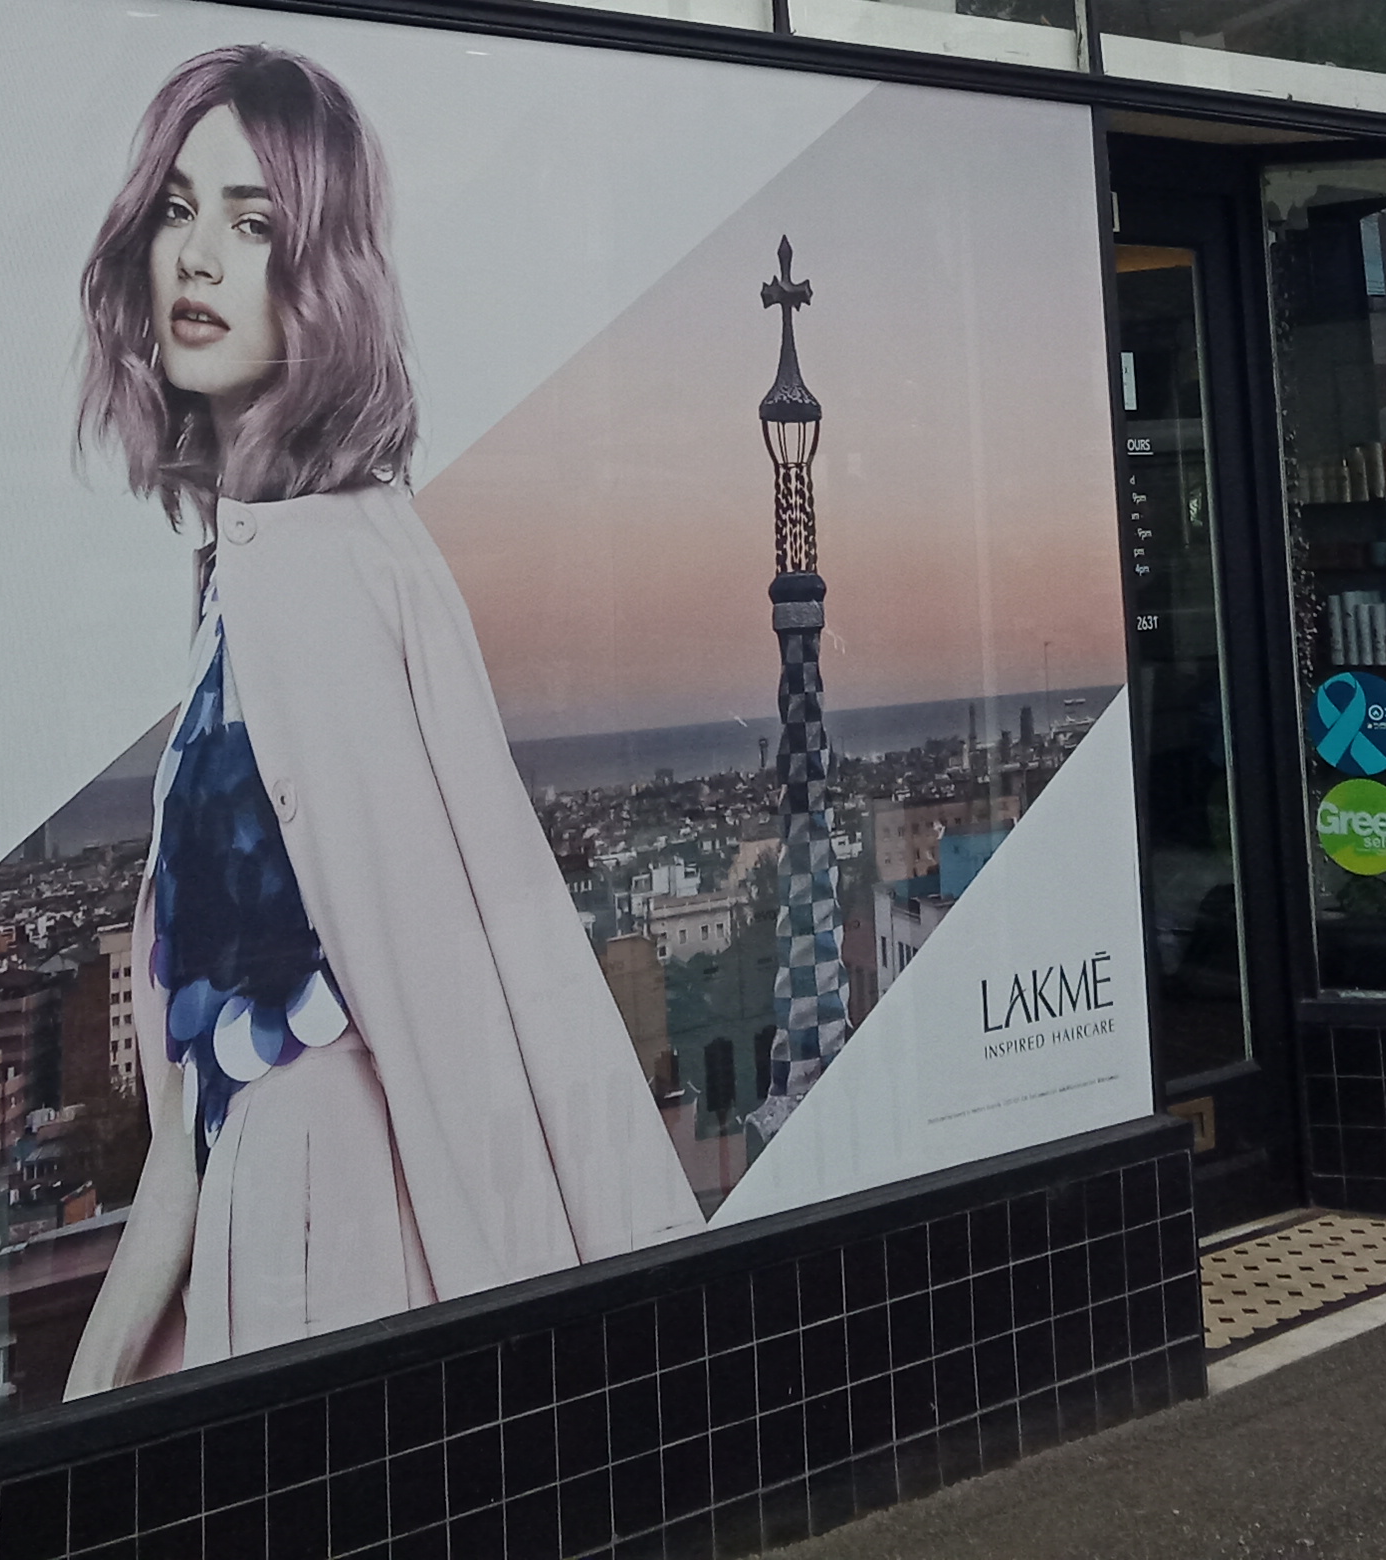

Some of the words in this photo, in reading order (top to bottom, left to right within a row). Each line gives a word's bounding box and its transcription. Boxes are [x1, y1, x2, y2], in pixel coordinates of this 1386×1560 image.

[1127, 439, 1151, 451] OURS
[981, 951, 1114, 1033] LAKMĒ
[984, 1033, 1045, 1060] INSPIRED
[1052, 1018, 1115, 1044] HAIRCARE
